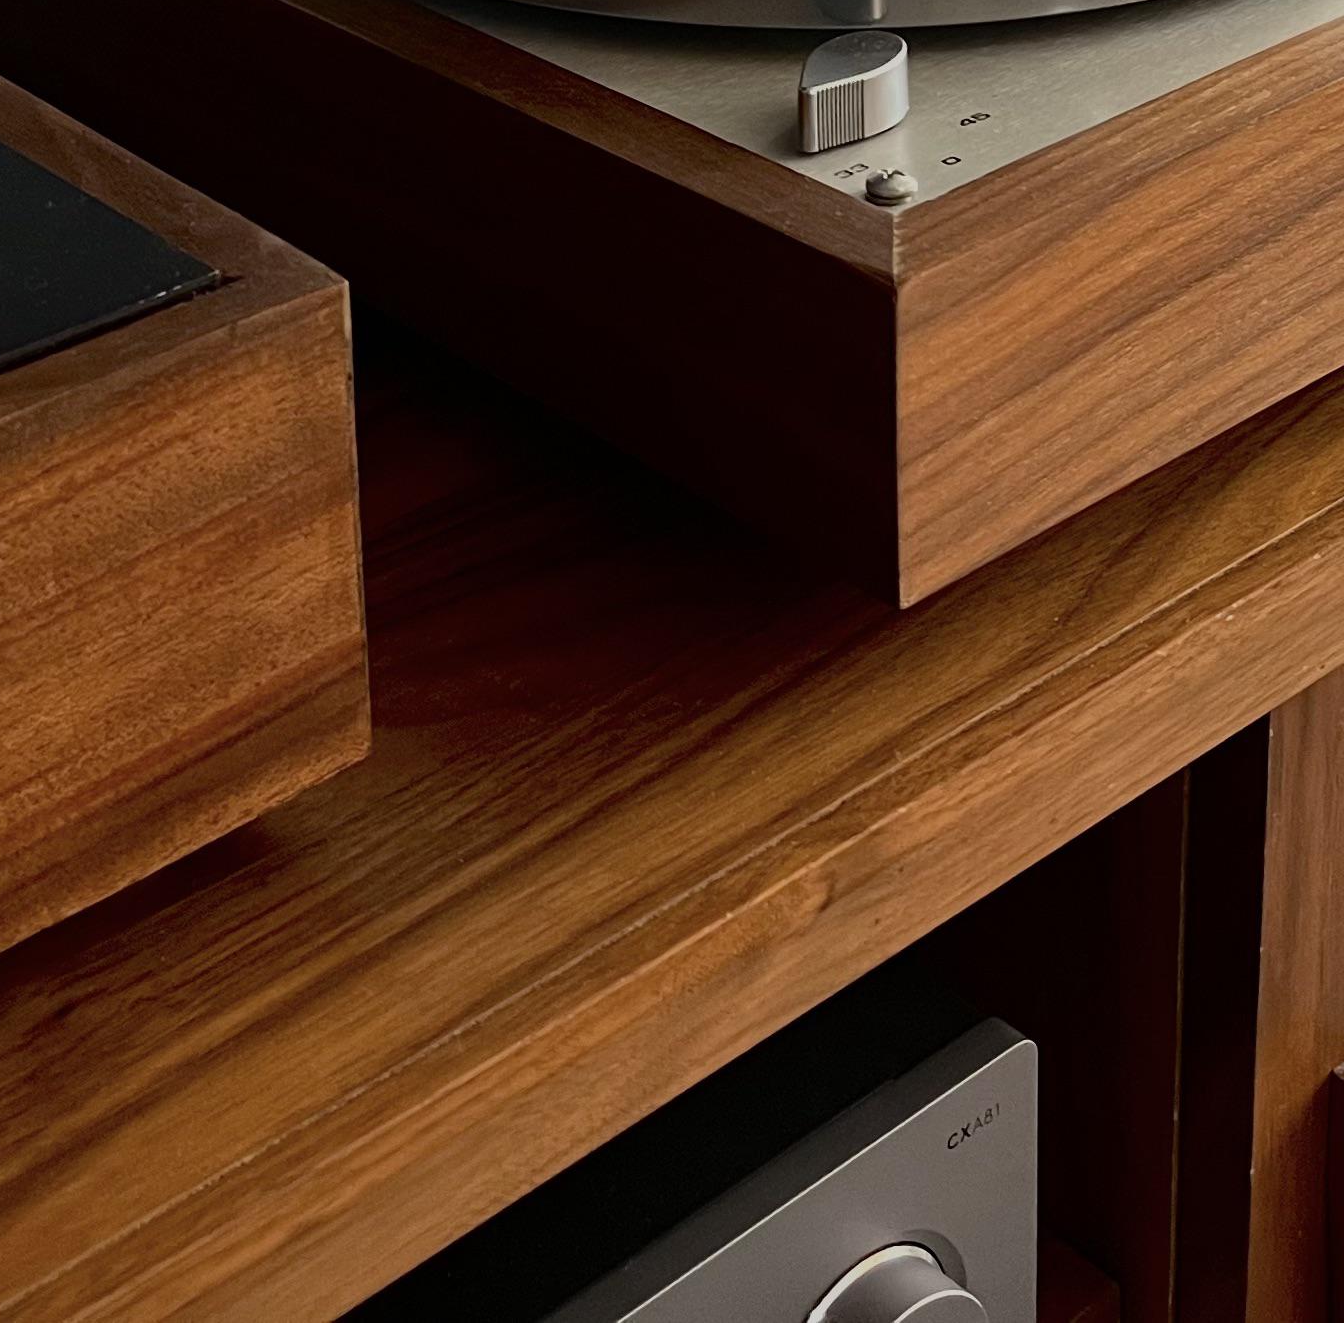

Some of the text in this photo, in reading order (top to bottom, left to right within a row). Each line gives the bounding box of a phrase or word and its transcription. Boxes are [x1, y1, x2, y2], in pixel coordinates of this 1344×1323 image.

[959, 112, 991, 127] 45
[834, 163, 870, 179] 33
[947, 1102, 1000, 1150] CXA81
